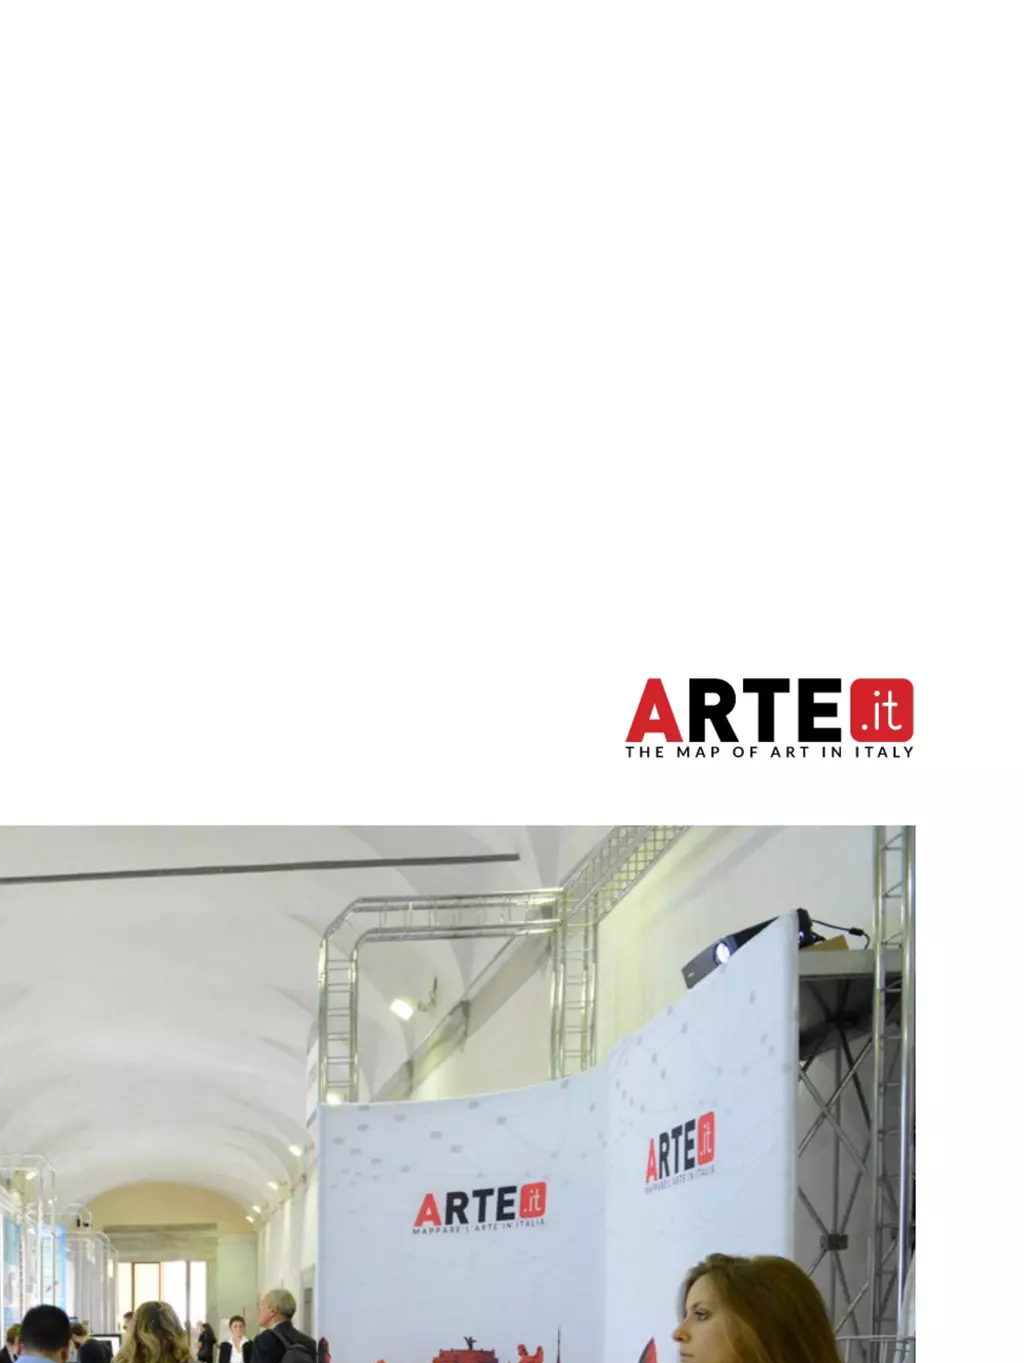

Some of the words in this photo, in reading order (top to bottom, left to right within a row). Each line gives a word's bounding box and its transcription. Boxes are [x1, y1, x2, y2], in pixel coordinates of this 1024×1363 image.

[412, 1225, 461, 1235] MAPPARE
[502, 1222, 512, 1231] IN
[516, 1218, 546, 1229] ITALIA
